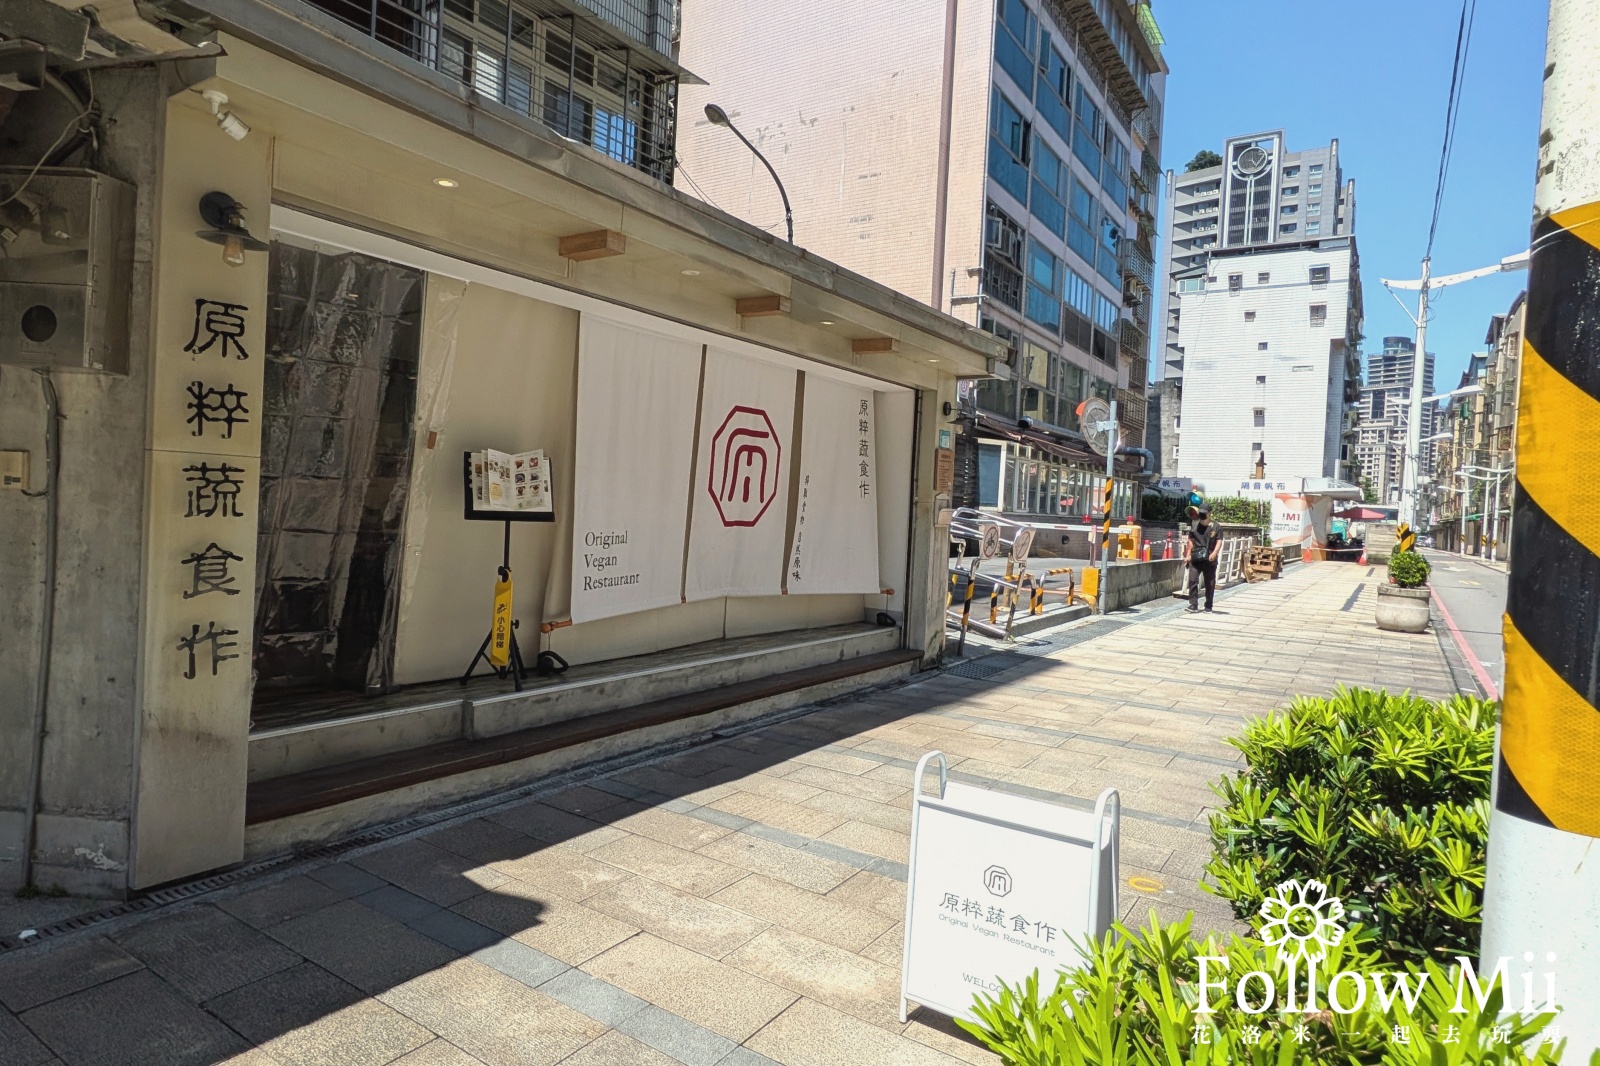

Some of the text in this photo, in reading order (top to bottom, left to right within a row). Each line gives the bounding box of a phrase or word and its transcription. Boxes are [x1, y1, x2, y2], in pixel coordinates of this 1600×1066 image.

[858, 399, 870, 499] 原粹蔬食作
[176, 298, 249, 680] 原粹蔬食作
[584, 530, 628, 549] Original
[583, 572, 640, 591] Restaurant
[584, 554, 618, 571] Vegan
[938, 914, 1056, 957] Original Vegan Restaurant
[939, 892, 1058, 943] 原粹蔬食作
